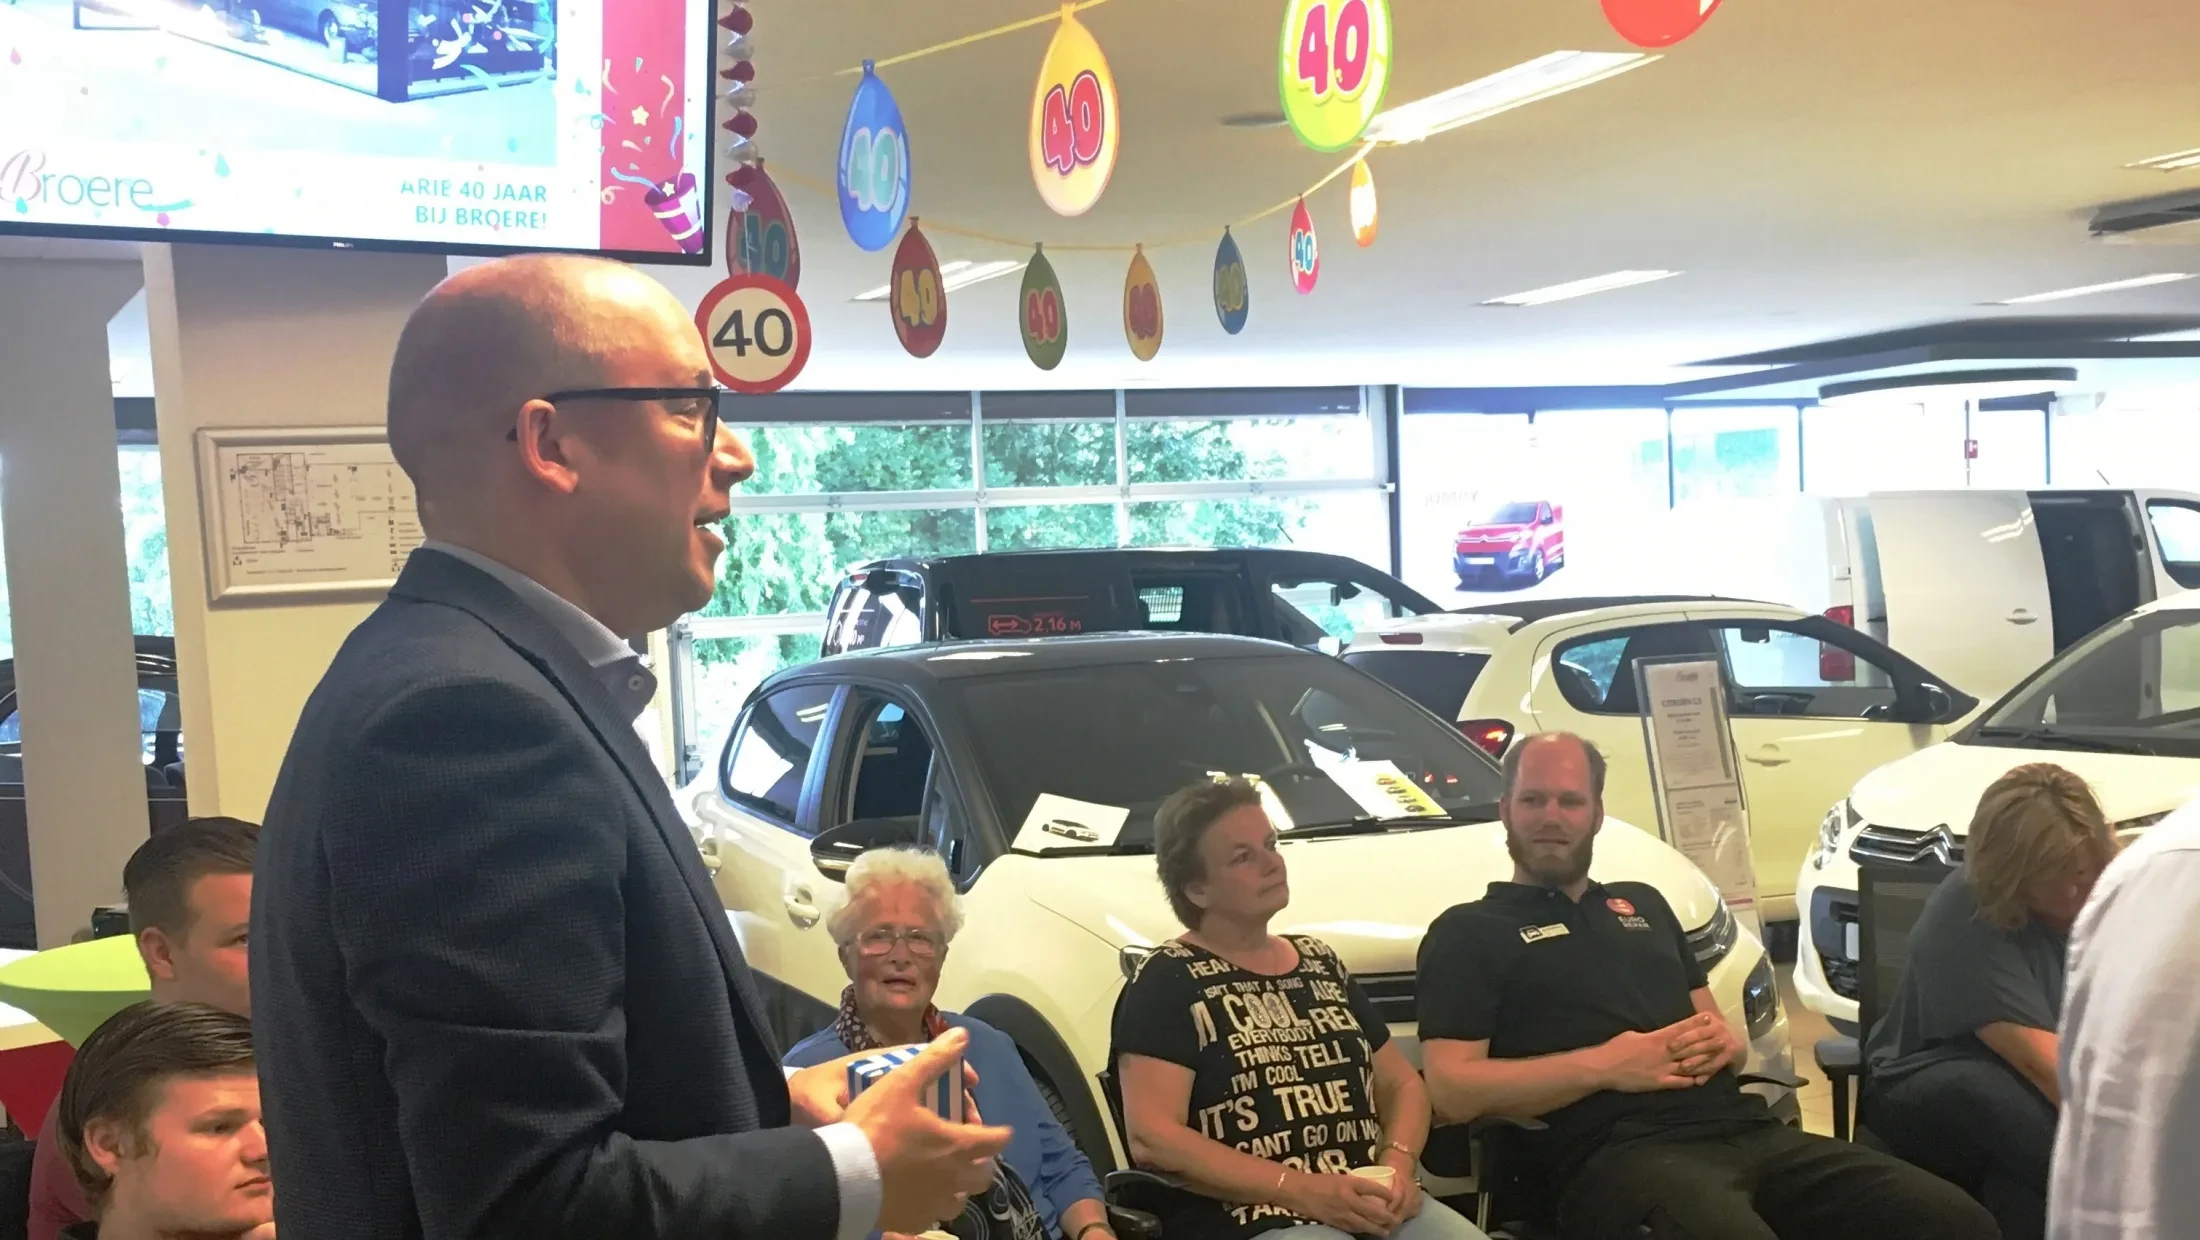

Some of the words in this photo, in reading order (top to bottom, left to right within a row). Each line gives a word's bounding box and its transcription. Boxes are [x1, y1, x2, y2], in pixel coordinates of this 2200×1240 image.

[1299, 0, 1369, 95] 40
[1043, 72, 1103, 174] 40
[0, 150, 154, 208] Broere
[400, 178, 451, 197] ARIE
[460, 182, 485, 199] 40
[493, 184, 547, 202] JAAR
[849, 128, 900, 211] 40
[416, 205, 447, 224] BIJ
[456, 208, 546, 229] BROERE!
[740, 211, 789, 279] 40
[1295, 229, 1314, 275] 40
[900, 268, 938, 328] 40
[1027, 287, 1060, 344] 40
[713, 308, 793, 357] 40
[1232, 980, 1260, 994] THAT
[1266, 979, 1275, 991] A
[1276, 976, 1304, 989] SONG
[1222, 991, 1311, 1031] COOL
[1227, 1025, 1315, 1050] EVERYBODY
[1235, 1044, 1292, 1068] THINKS
[1293, 1040, 1352, 1069] TELL
[1231, 1070, 1258, 1095] I'M
[1265, 1064, 1304, 1086] COOL
[1199, 1095, 1260, 1140] IT'S
[1273, 1080, 1353, 1122] TRUE
[1303, 1124, 1328, 1148] GO
[1337, 1121, 1357, 1143] ON
